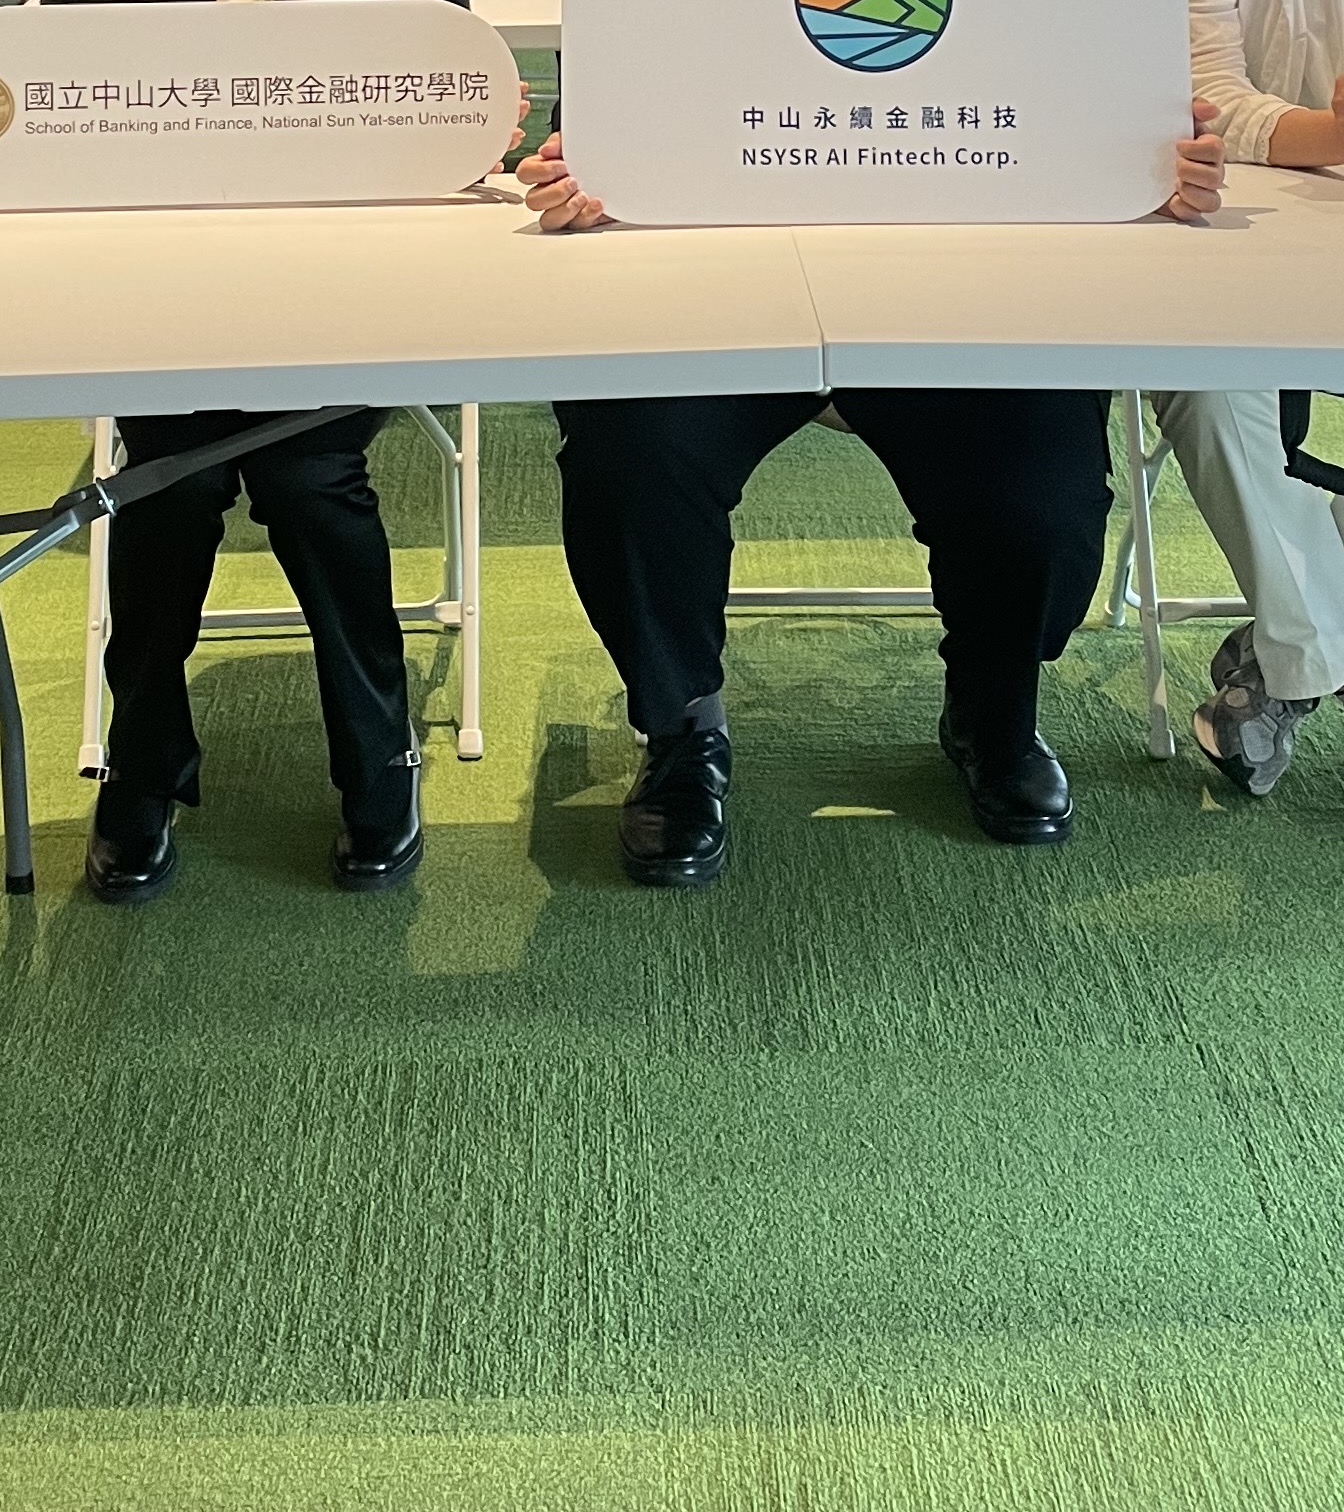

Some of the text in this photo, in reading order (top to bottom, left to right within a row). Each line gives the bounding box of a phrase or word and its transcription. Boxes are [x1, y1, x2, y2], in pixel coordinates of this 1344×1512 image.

[25, 71, 489, 112] 國立中山大學 國際金融研究學院
[25, 112, 489, 135] School of Banking and Finance, National Sun Yat-sen University
[742, 105, 1017, 130] 中山永續金融科技
[742, 146, 1019, 169] NSYSR AI Fintech Corp.
